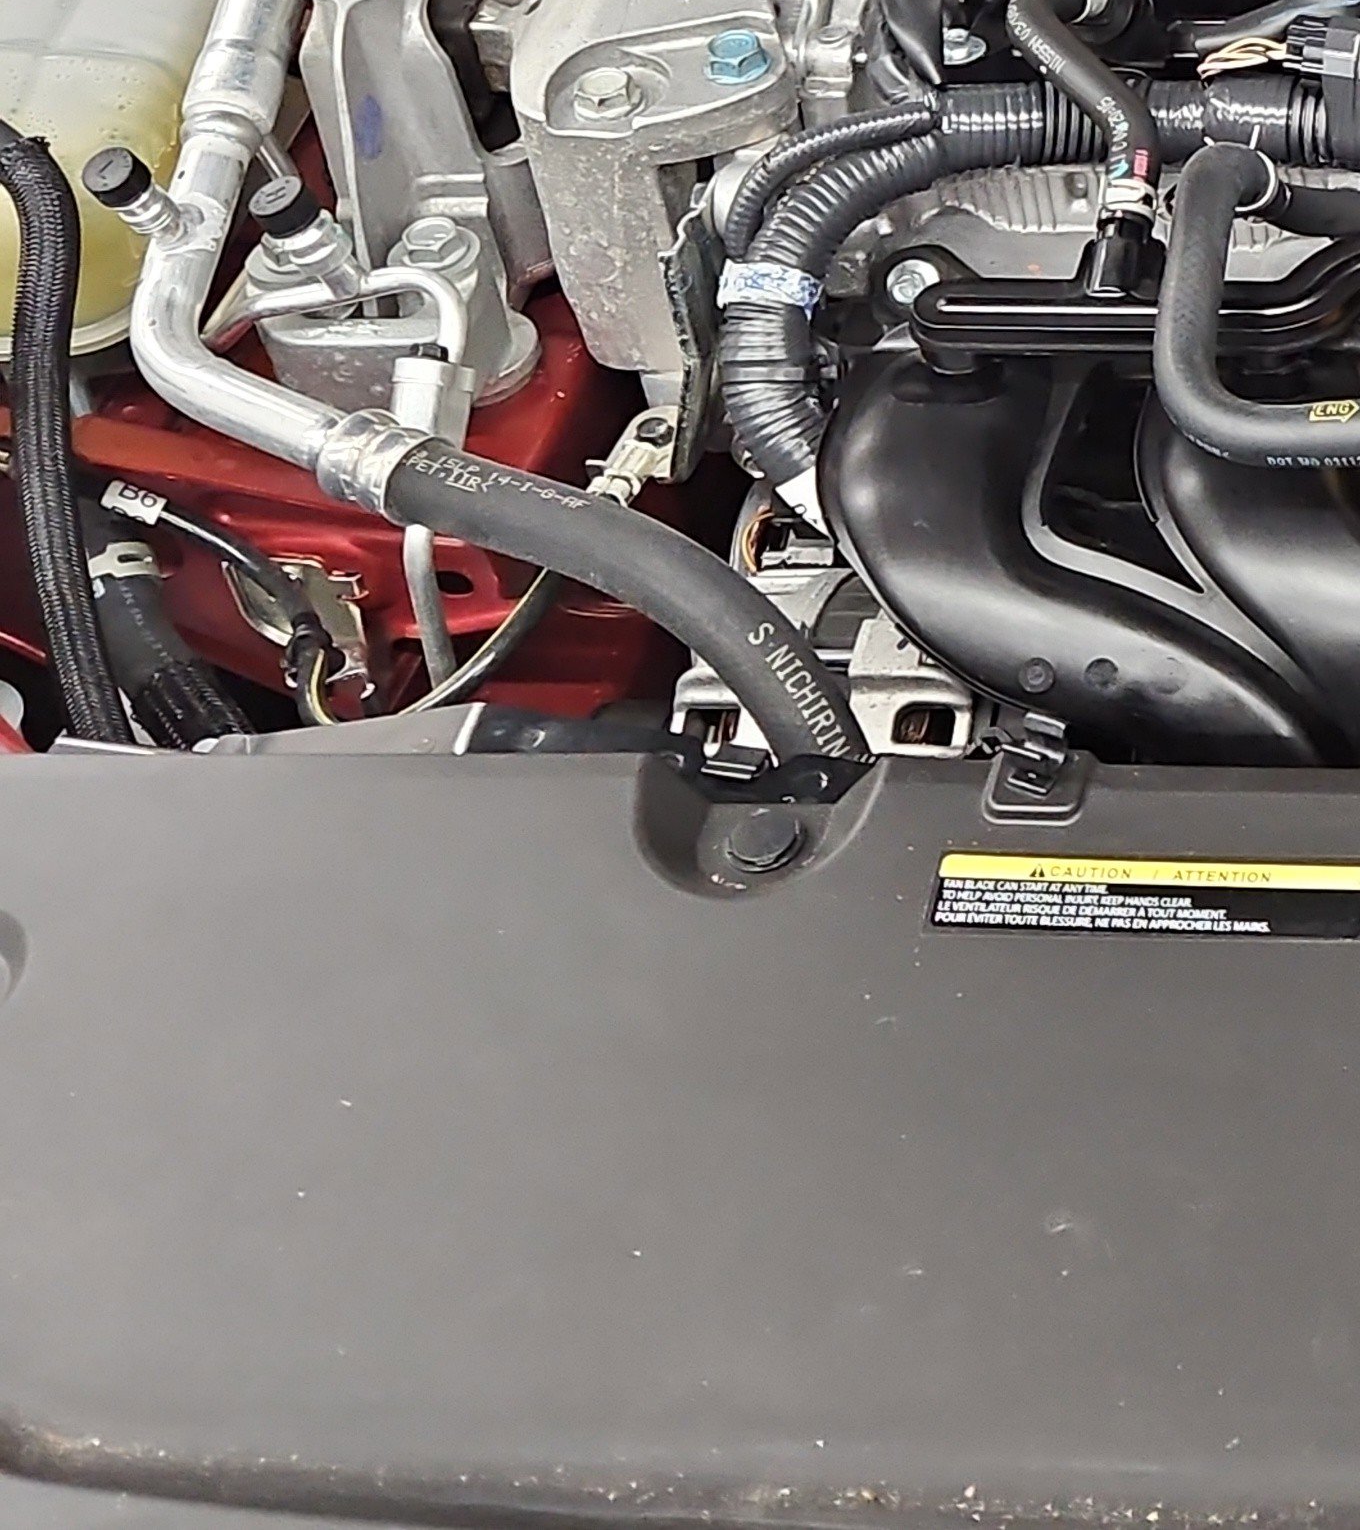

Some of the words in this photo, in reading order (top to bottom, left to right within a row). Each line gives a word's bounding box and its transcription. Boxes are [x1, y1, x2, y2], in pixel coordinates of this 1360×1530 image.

[1050, 865, 1132, 880] CAUTION
[1173, 870, 1272, 883] ATTENTION
[943, 879, 963, 889] FAN
[997, 881, 1018, 891] CAN
[1019, 882, 1048, 892] START
[1049, 883, 1062, 892] AT
[1063, 883, 1085, 893] ANY
[942, 890, 956, 900] TO
[958, 890, 982, 901] HELP
[1013, 892, 1063, 904] PERSONAL
[1100, 895, 1125, 905] KEEP
[1125, 896, 1159, 907] HANDS
[937, 900, 951, 911] LE
[953, 901, 1022, 913] VENTILATEUR
[1023, 903, 1061, 914] RISQUE
[1062, 904, 1077, 915] DE
[1147, 908, 1177, 919] TOUT
[934, 911, 966, 923] POUR
[1004, 914, 1039, 925] TOUTE
[1094, 917, 1109, 928] NE
[1110, 918, 1131, 929] PAS
[1132, 919, 1147, 930] EN
[1148, 920, 1213, 932] APPROCHER
[1213, 921, 1232, 931] LES
